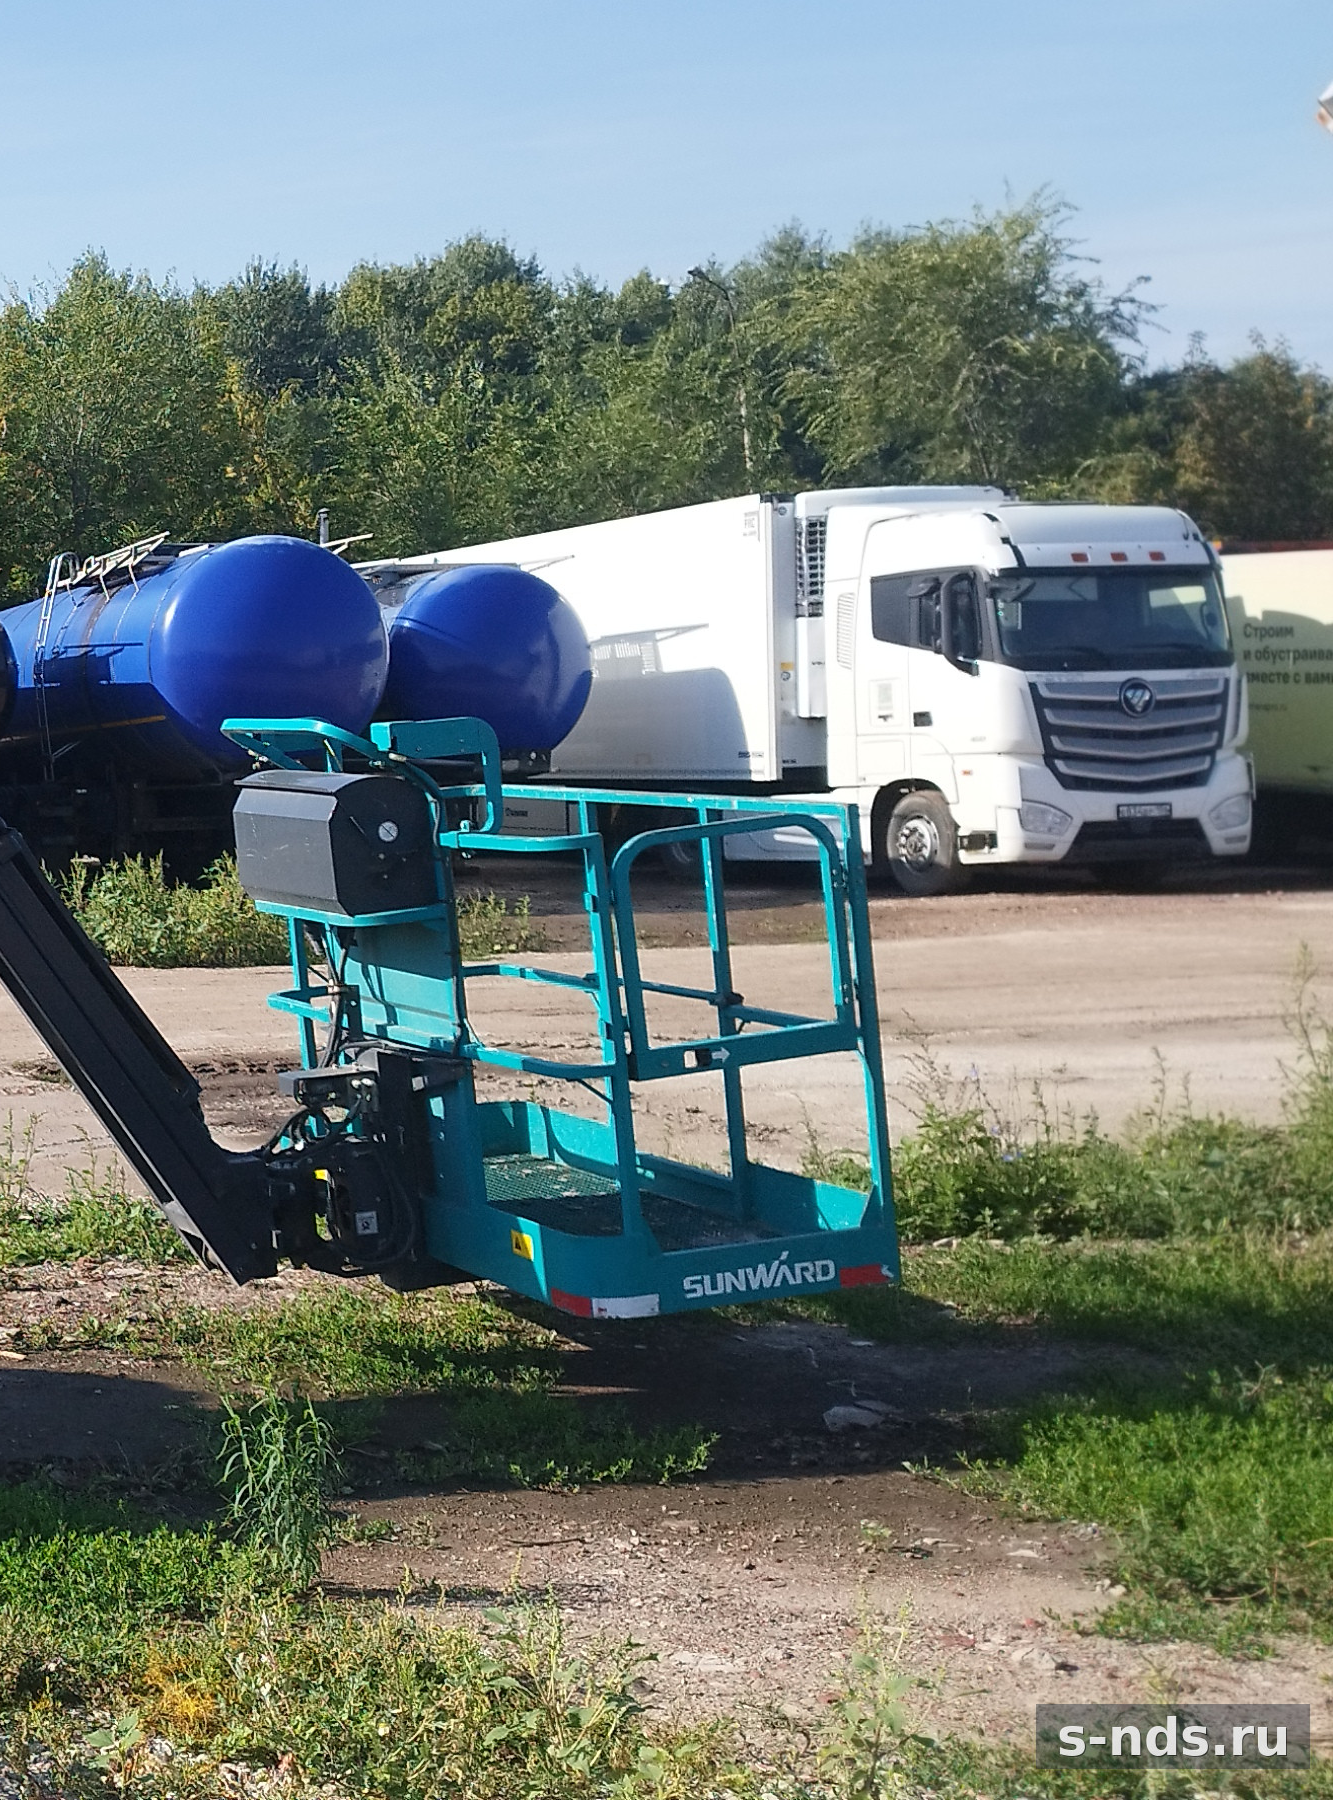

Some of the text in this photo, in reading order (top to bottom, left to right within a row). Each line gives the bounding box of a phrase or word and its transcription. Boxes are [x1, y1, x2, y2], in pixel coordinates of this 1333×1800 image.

[1244, 623, 1294, 641] Строим
[1243, 650, 1251, 660] и
[1294, 672, 1302, 684] с
[1305, 672, 1333, 684] вам
[683, 1251, 836, 1299] SUNWARD
